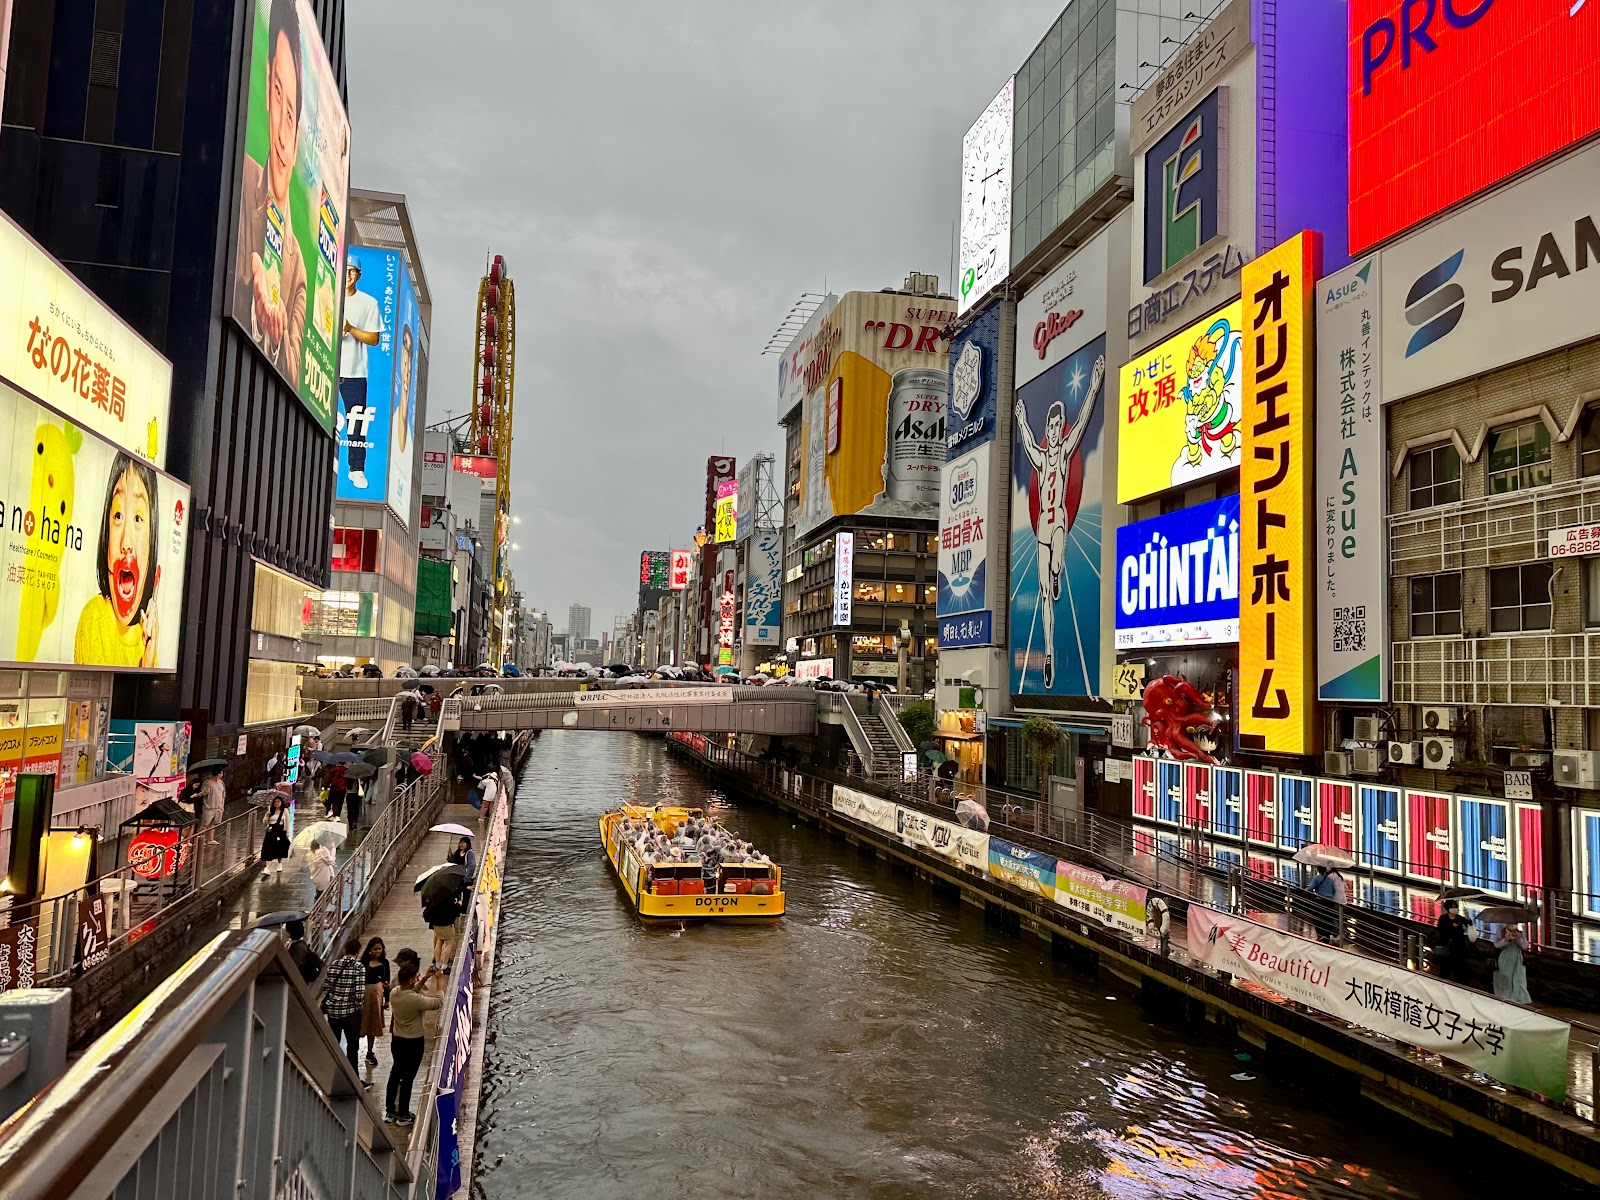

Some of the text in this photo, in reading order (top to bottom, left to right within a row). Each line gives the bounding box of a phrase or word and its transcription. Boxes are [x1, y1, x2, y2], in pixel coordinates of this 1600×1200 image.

[1146, 41, 1227, 133] エステムシリーズ
[1155, 31, 1215, 100] 夢ある住まい
[380, 254, 396, 357] いこう、あたらしい世界。
[1128, 244, 1244, 340] 日商エステム
[1326, 279, 1358, 304] Asue
[905, 307, 958, 323] SUPER
[1033, 309, 1084, 360] Glico
[26, 316, 126, 423] なの花薬局
[1132, 354, 1173, 387] かぜに
[1361, 308, 1372, 424] 丸善インテックは、
[915, 393, 939, 401] SUPER
[1128, 371, 1177, 424] 改源
[907, 464, 941, 472] スーパードラ
[917, 444, 933, 456] 生
[1339, 346, 1358, 559] 株式会社 Asue
[1047, 467, 1057, 525] グリコ
[1252, 270, 1290, 720] オリエントホーム
[717, 502, 725, 541] バイト
[942, 515, 984, 550] 毎日骨太
[9, 541, 34, 557] Healthcare
[37, 549, 58, 563] Cosmetics
[951, 549, 972, 575] MBP
[1121, 517, 1239, 616] CHINTAI
[1326, 496, 1336, 598] に変わりました。
[7, 562, 36, 587] 油菜花
[840, 579, 849, 622] かに道楽
[1226, 669, 1232, 706] 2F
[611, 716, 670, 726] えびす橋
[1504, 772, 1532, 786] BAR
[695, 897, 738, 906] DOTON
[1221, 957, 1244, 969] OSAKA
[1290, 985, 1327, 1003] UNIVERSITY
[1229, 933, 1331, 988] 美 Beautiful
[1344, 977, 1506, 1056] 大阪樟蔭女子大学
